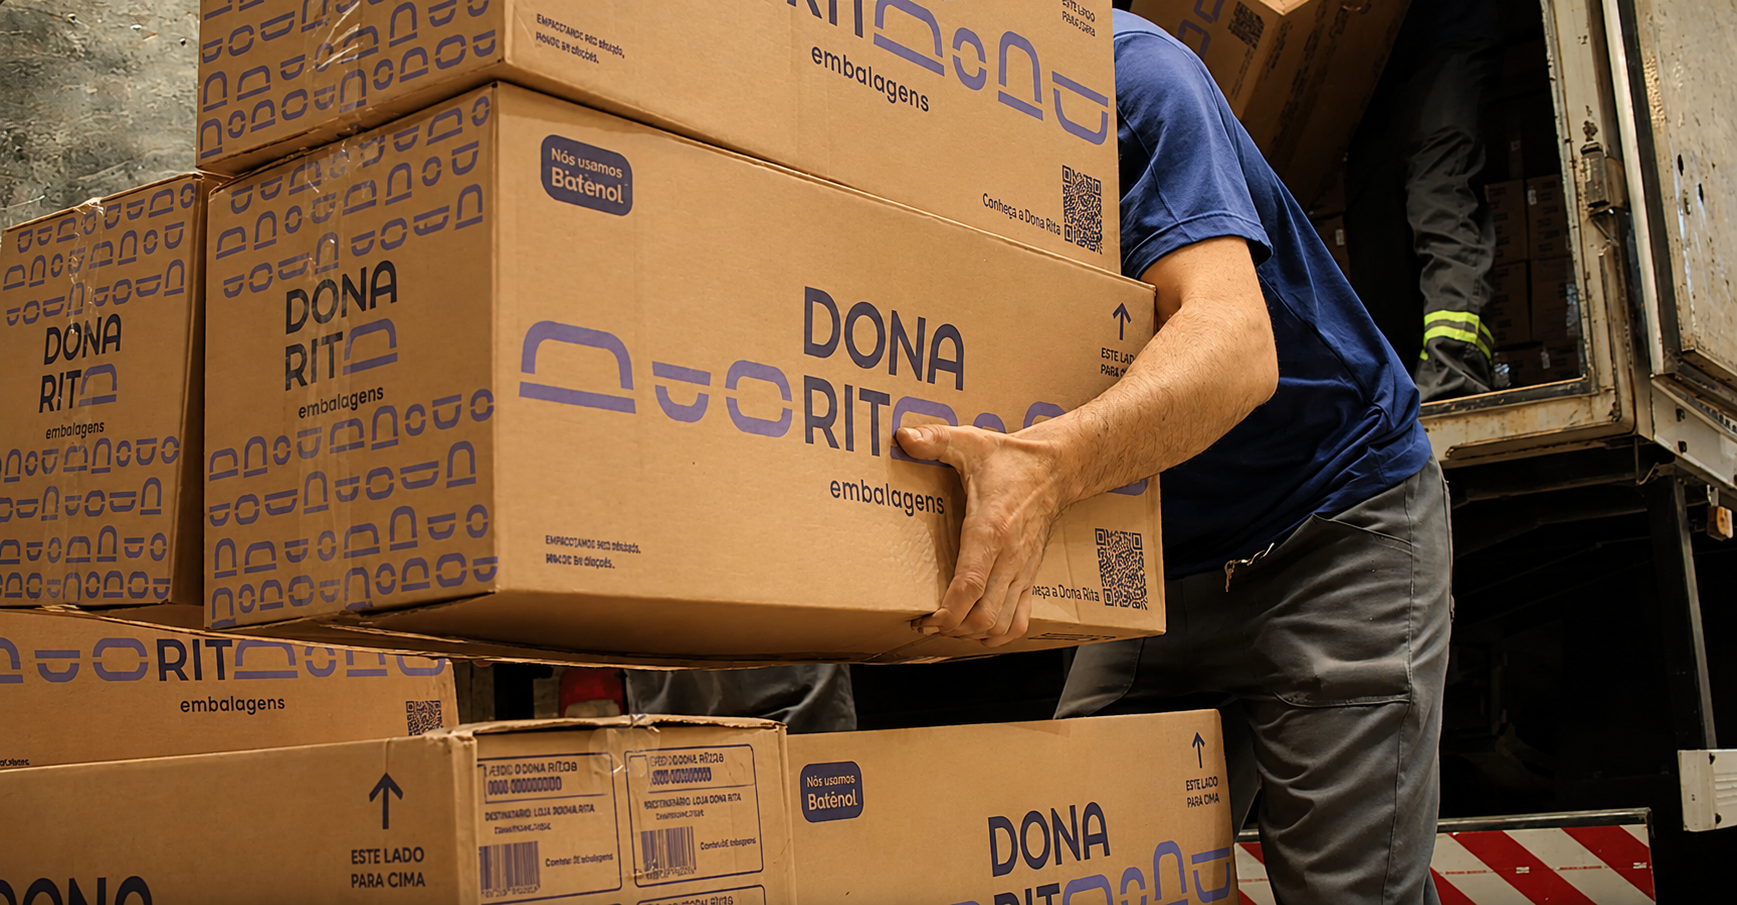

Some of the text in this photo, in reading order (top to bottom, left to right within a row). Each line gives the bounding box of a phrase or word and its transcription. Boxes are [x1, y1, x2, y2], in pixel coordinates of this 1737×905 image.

[811, 46, 929, 112] embalagens
[551, 147, 623, 179] Nós usamos
[982, 192, 1061, 236] Conheça a Dona Rita
[286, 260, 398, 334] DONA
[44, 313, 122, 365] DONA
[803, 286, 965, 391] DONA
[1100, 347, 1136, 365] ESTE LAD
[298, 386, 385, 419] embalagens
[45, 420, 105, 440] embalagens
[830, 479, 945, 517] embalagens
[1051, 587, 1058, 598] a
[1058, 584, 1082, 600] Dona
[1082, 587, 1100, 602] Rita
[180, 695, 286, 715] embalagens
[806, 775, 856, 788] Nós usamos
[1185, 776, 1219, 791] ESTE LADO
[1186, 795, 1203, 808] PARA
[987, 801, 1111, 878] DONA
[351, 846, 425, 865] ESTE LADO
[351, 871, 426, 889] PARA CIMA
